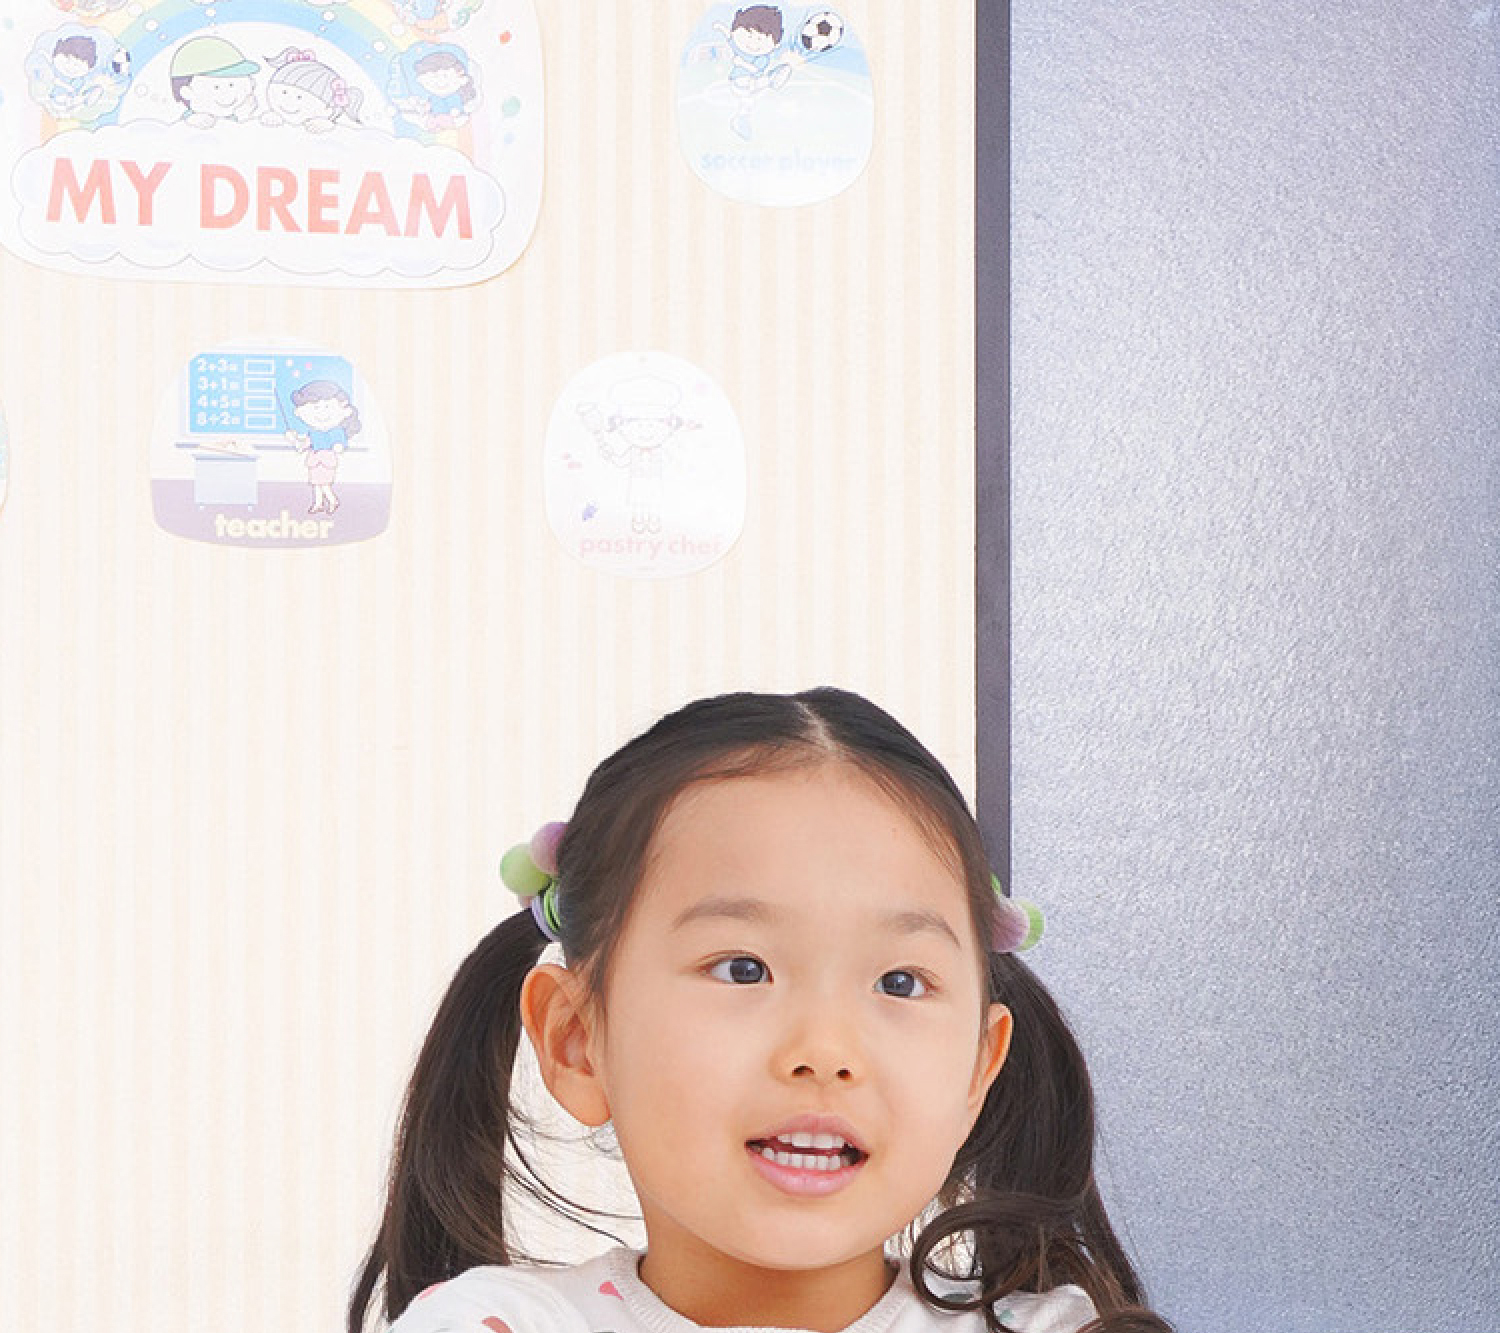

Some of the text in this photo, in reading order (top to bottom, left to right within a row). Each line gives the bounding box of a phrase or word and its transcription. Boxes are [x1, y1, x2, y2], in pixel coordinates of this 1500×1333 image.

[46, 157, 474, 240] MY DREAM
[215, 510, 334, 539] teacher
